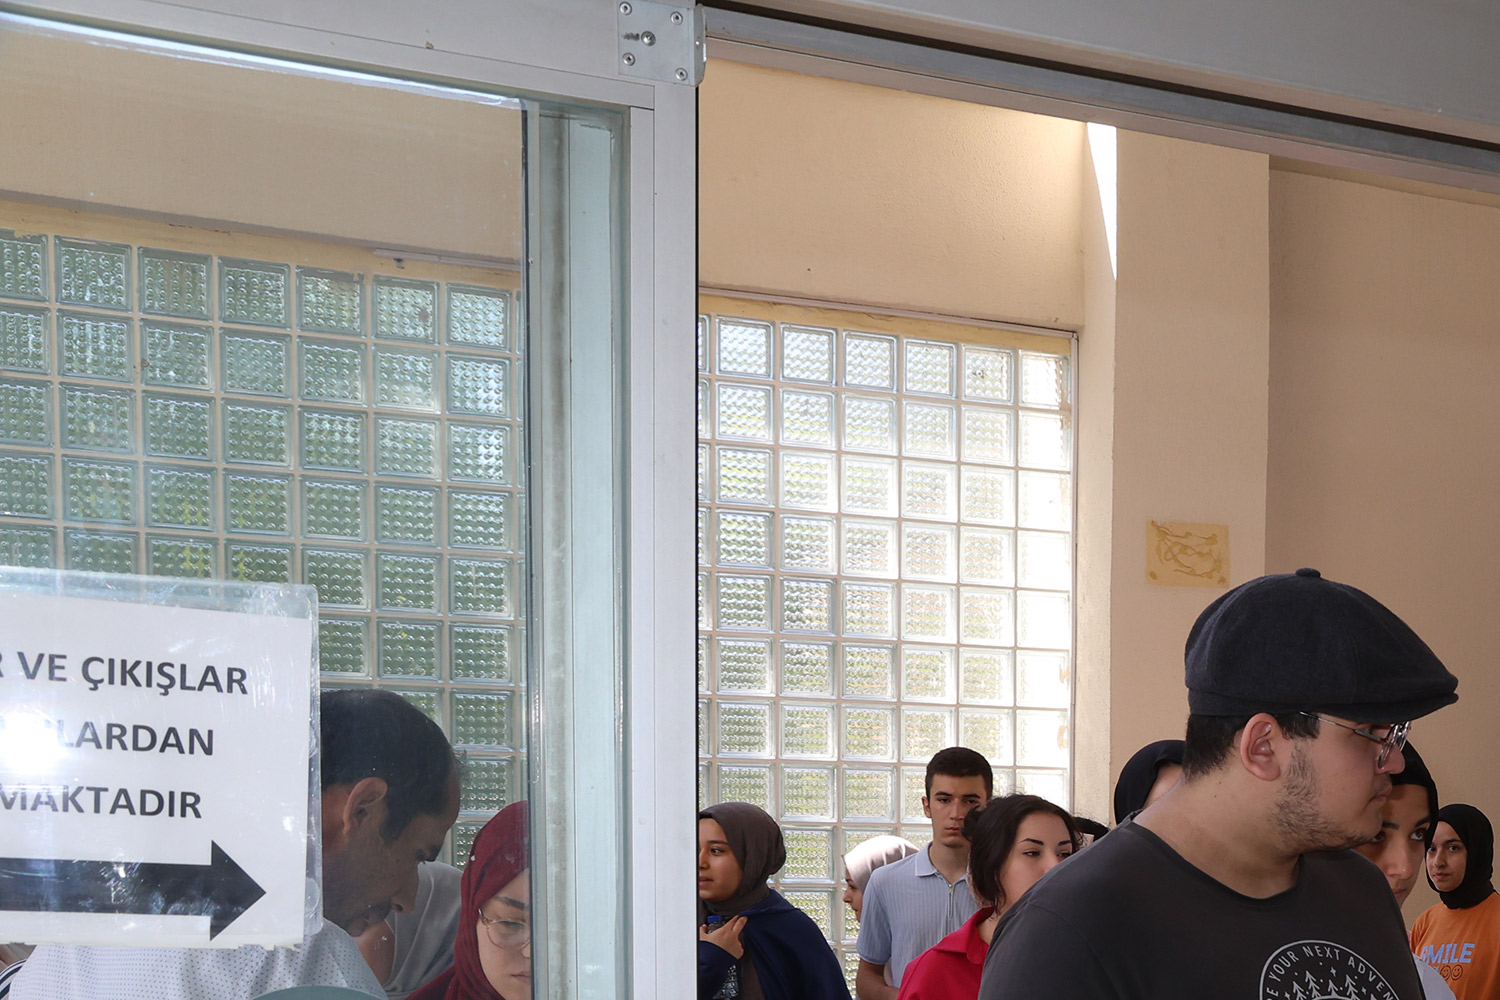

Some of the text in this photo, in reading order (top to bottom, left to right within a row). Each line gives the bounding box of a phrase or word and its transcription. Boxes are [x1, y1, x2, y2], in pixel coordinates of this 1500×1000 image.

[17, 651, 67, 682] VE
[81, 656, 249, 696] ÇIKIŞLAR
[0, 719, 214, 756] LARDAN
[1268, 951, 1299, 982] YOUR
[1302, 945, 1341, 961] NEXT
